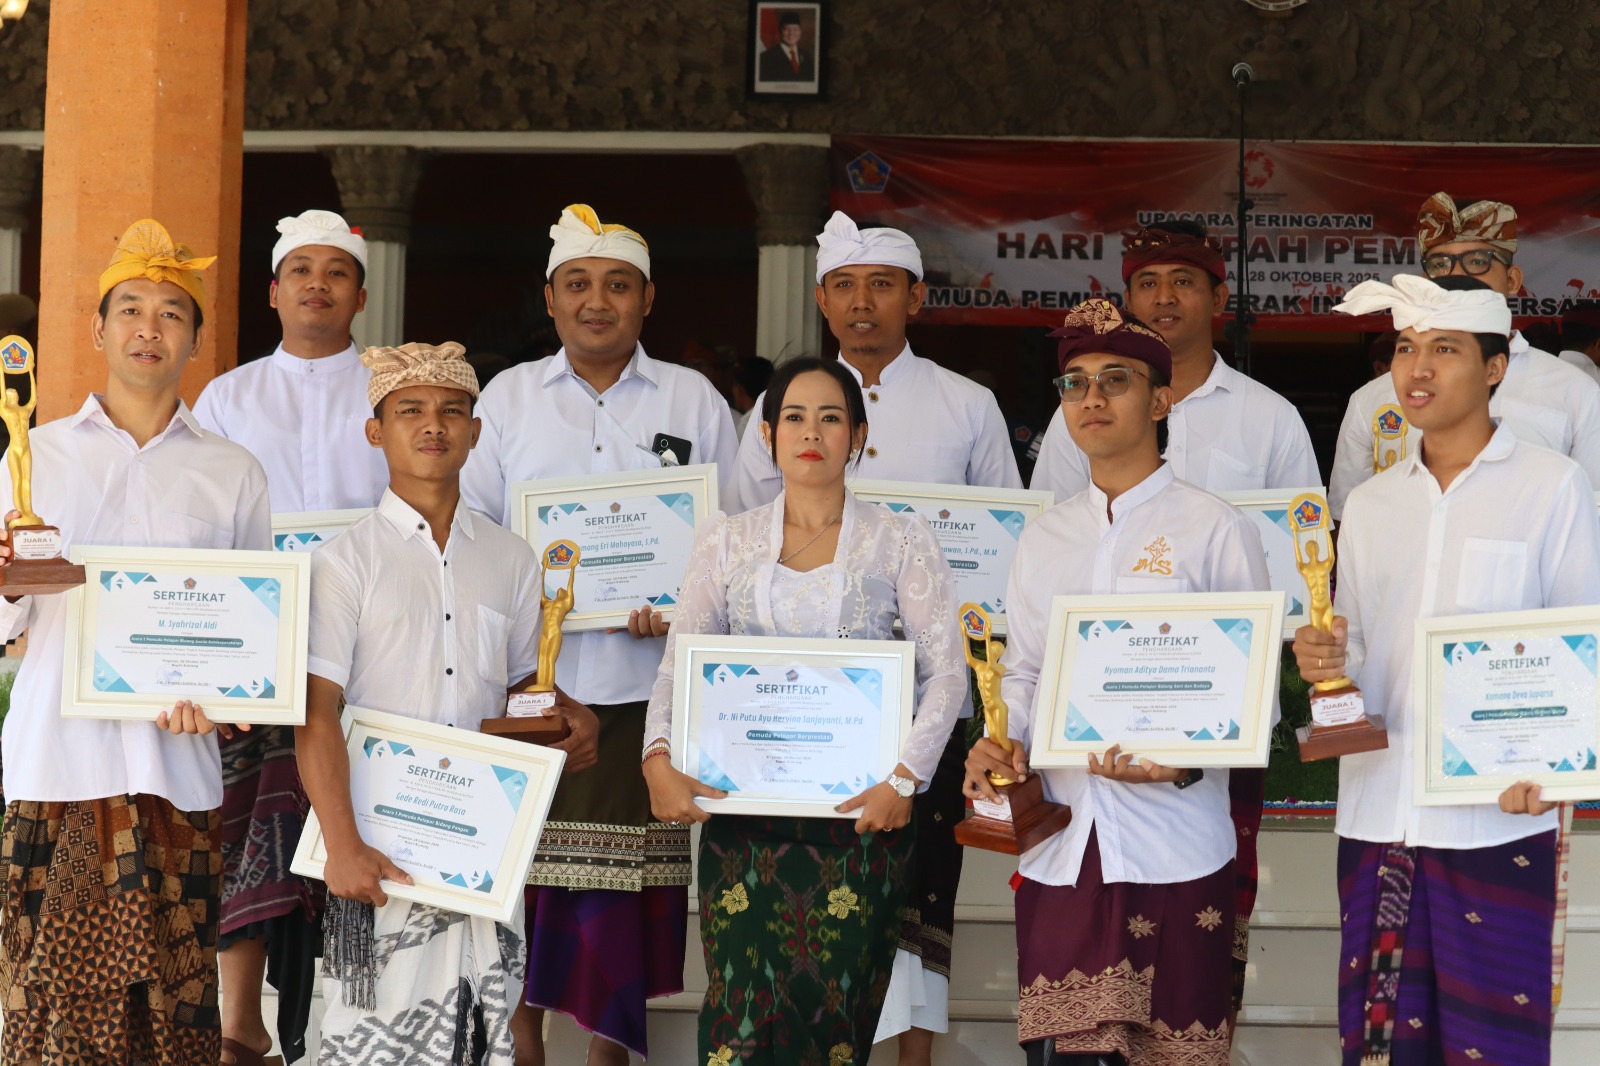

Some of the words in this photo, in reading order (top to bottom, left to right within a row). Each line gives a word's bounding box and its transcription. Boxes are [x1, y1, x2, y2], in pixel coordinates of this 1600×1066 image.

[1138, 212, 1235, 227] UPACARA
[1244, 213, 1373, 229] PERINGATAN
[996, 231, 1104, 260] HARI
[1323, 237, 1416, 265] PEM
[1249, 271, 1265, 282] 28
[1269, 271, 1343, 284] OKTOBER
[1347, 272, 1380, 284] 2025
[924, 288, 1011, 309] MUDA
[584, 513, 647, 526] SERTIFIKAT
[928, 520, 977, 531] TIFIKAT
[580, 558, 602, 566] Pemuda
[153, 590, 226, 603] SERTIFIKAT
[158, 619, 168, 628] M.
[168, 619, 203, 631] Syahrizal
[203, 620, 219, 630] Aldi
[1128, 636, 1200, 647] SERTIFIKAT
[1489, 656, 1551, 670] SERTIFIKAT
[1103, 665, 1134, 676] Nyoman
[1134, 664, 1157, 676] Aditya
[756, 683, 829, 695] SERTIFIKAT
[1321, 702, 1349, 710] JUARA
[718, 712, 729, 721] Dr.
[730, 712, 739, 721] Ni
[739, 712, 757, 722] Putu
[758, 713, 771, 724] Ayu
[748, 731, 772, 739] Pemuda
[773, 732, 797, 740] Pelopor
[797, 733, 832, 742] Berprestasi
[407, 765, 475, 787] SERTIFIKAT
[429, 799, 450, 812] Putra
[449, 803, 466, 816] Rasa
